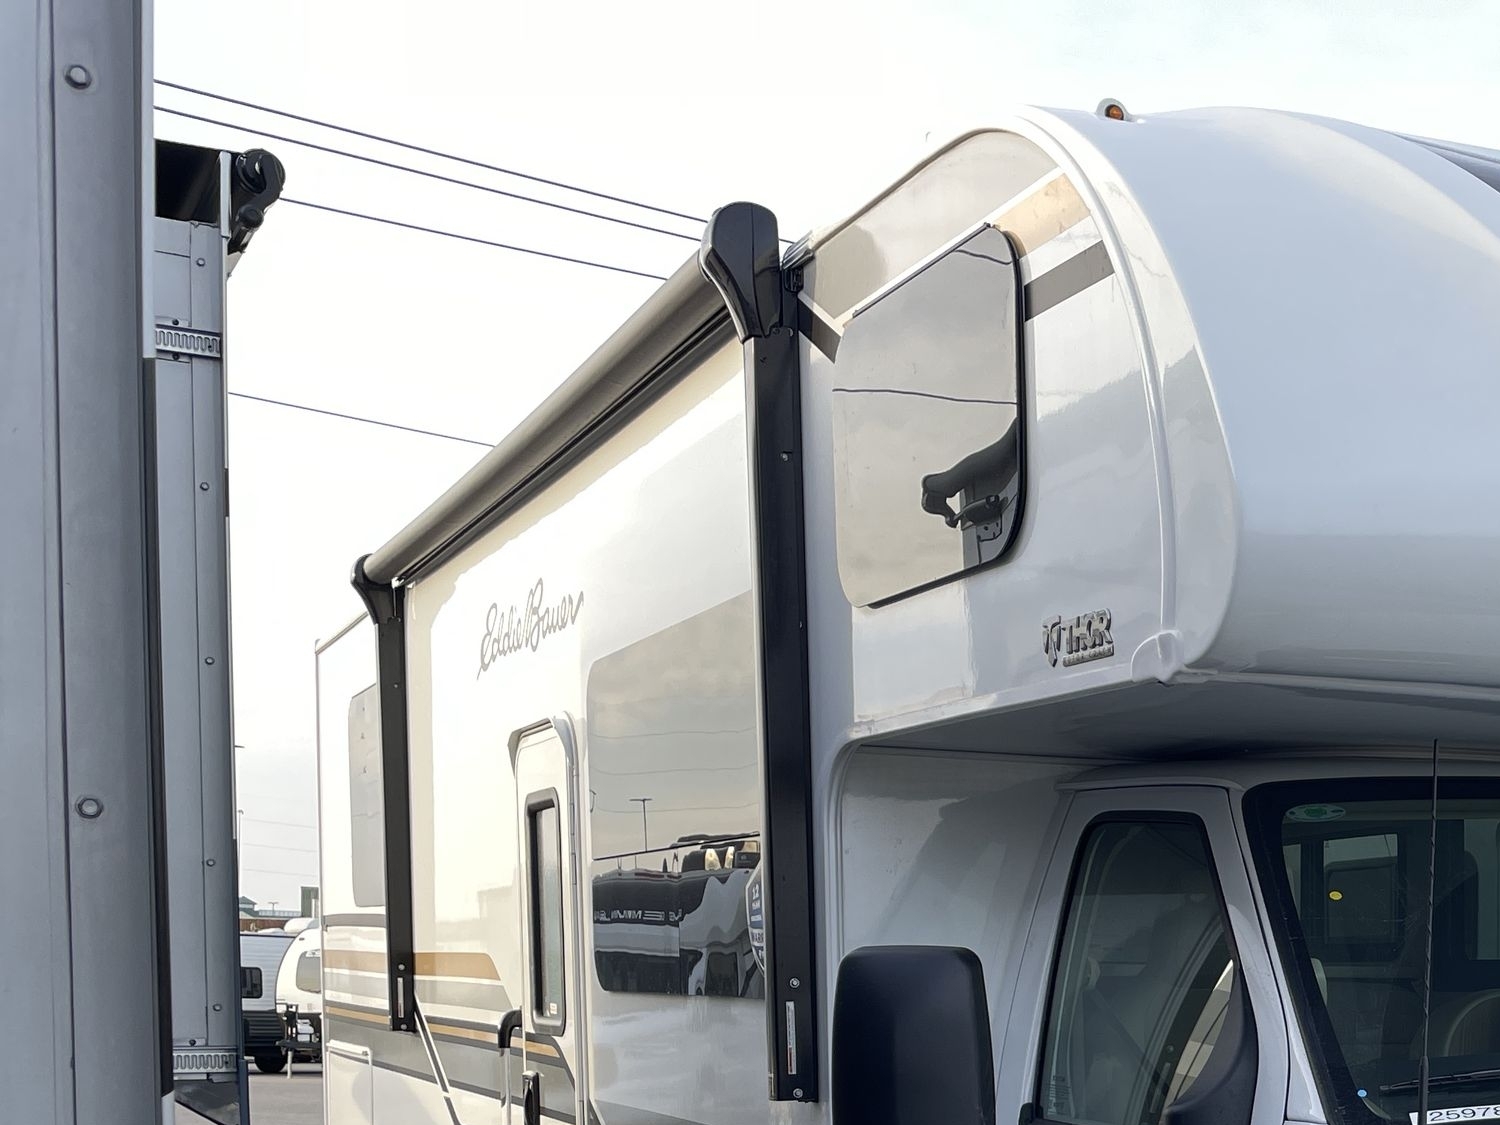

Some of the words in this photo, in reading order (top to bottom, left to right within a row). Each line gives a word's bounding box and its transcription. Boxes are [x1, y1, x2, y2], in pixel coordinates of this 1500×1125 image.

[476, 602, 524, 681] Eddie
[524, 577, 584, 653] Bauer
[1061, 608, 1114, 655] THOR
